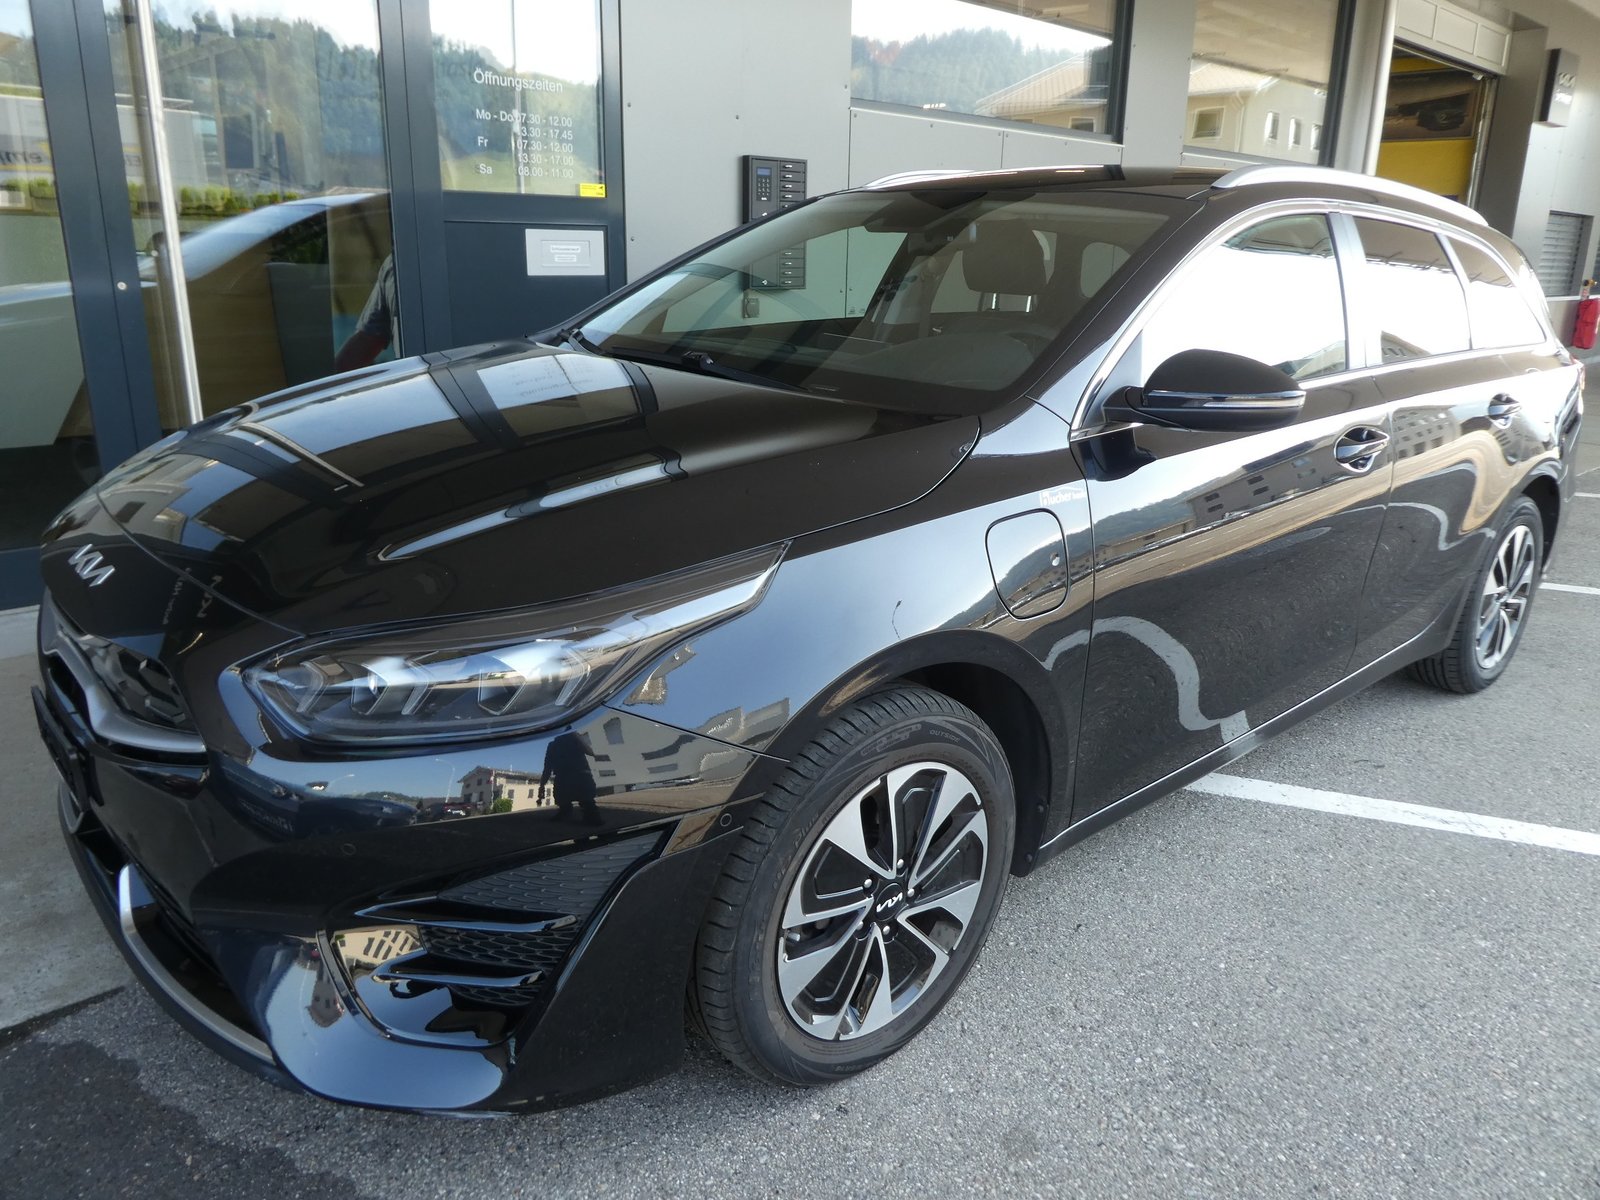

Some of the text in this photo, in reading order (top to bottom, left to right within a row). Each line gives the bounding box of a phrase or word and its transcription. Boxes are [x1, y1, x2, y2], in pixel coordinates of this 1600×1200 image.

[473, 67, 563, 92] Öffnungszeiten
[476, 109, 491, 120] Mo
[549, 116, 573, 127] 12.00
[518, 126, 541, 138] 3.30
[550, 129, 573, 140] 17.45
[477, 136, 489, 147] Fr
[516, 140, 542, 151] 07.30
[550, 142, 574, 153] 12.00
[518, 153, 542, 164] 13.30
[551, 155, 574, 166] 17.00
[479, 163, 493, 175] Sa
[518, 166, 543, 177] 08.00
[551, 168, 574, 178] 11.00
[68, 543, 115, 587] KIA
[929, 729, 960, 743] OUTSIDE
[876, 892, 903, 913] KIA
